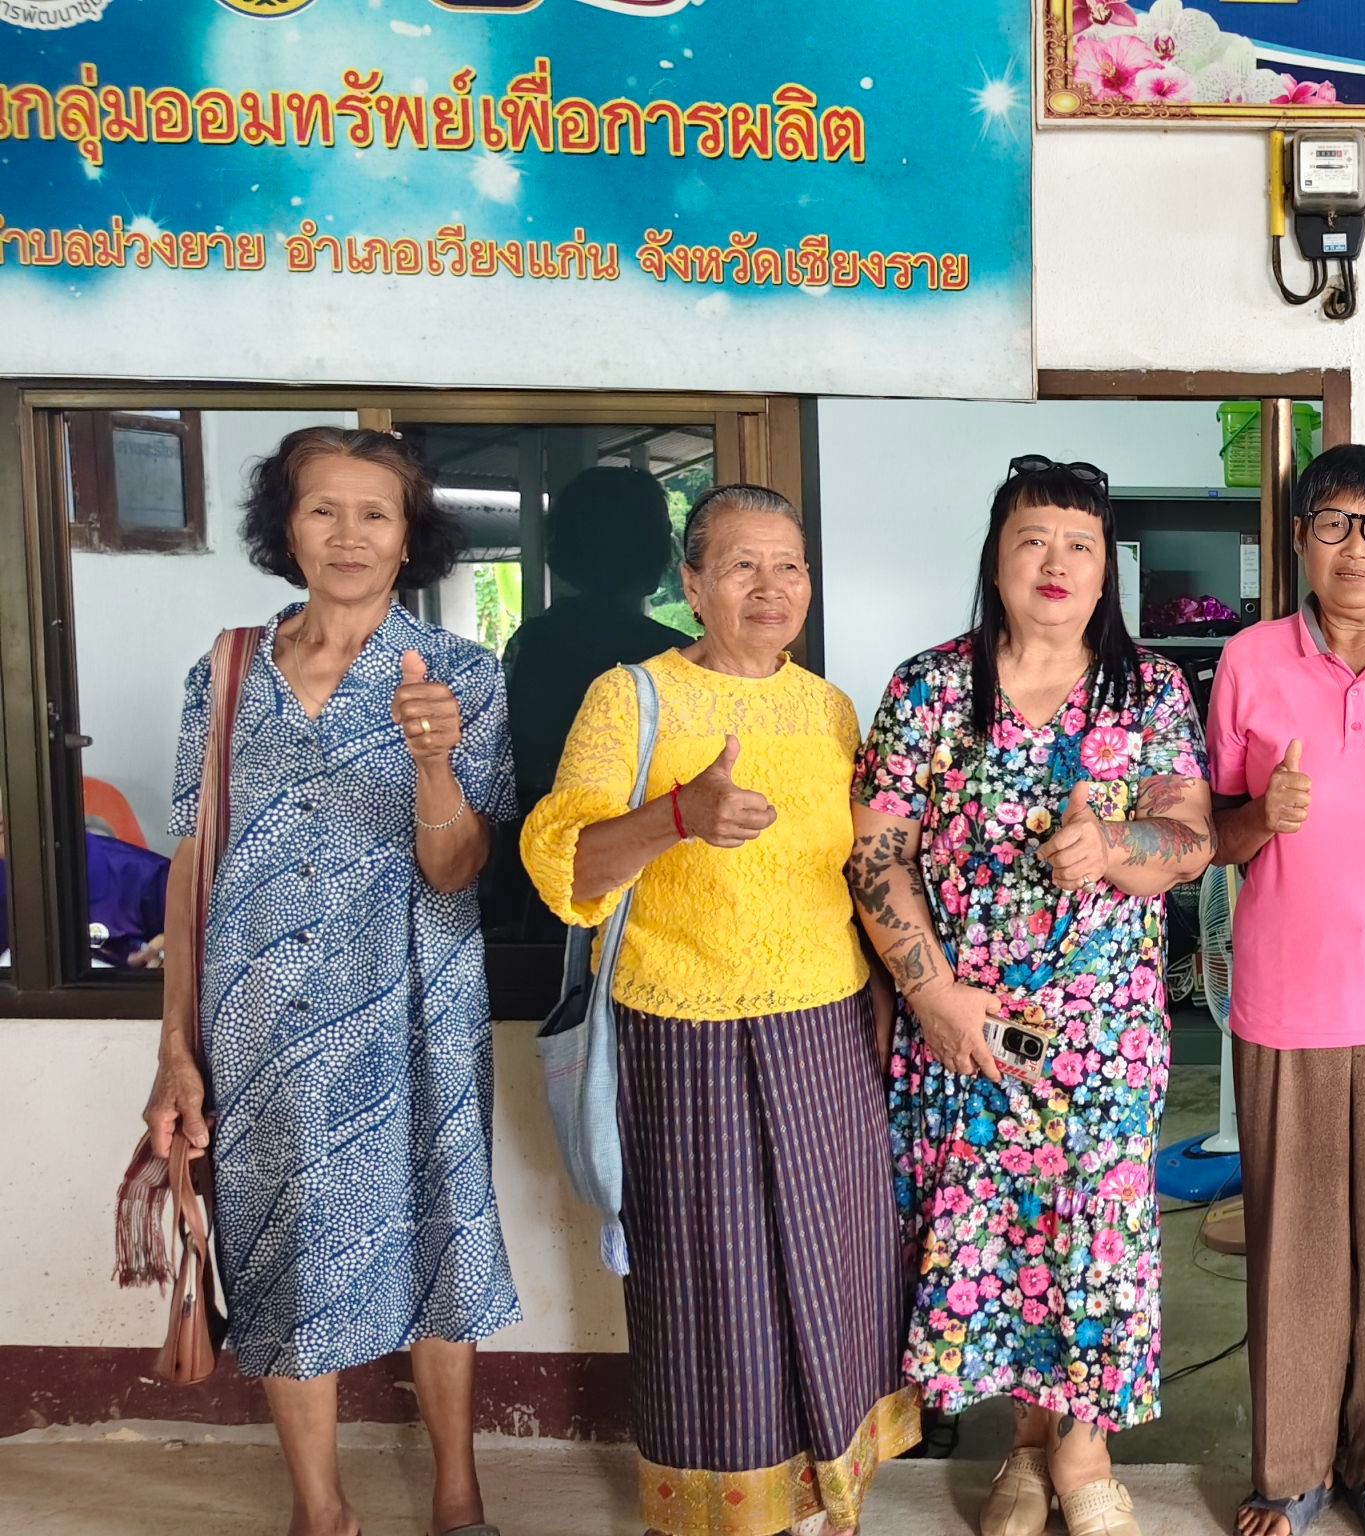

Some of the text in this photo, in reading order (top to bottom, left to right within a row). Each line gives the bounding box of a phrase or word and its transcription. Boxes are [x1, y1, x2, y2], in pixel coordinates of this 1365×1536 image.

[0, 57, 866, 164] กลุ่มออมทรัพย์เพื่อการผลิต
[0, 214, 971, 291] ำบลม่วงยาย อำเภอเวียงแก่น จังหวัดเชียงราย
